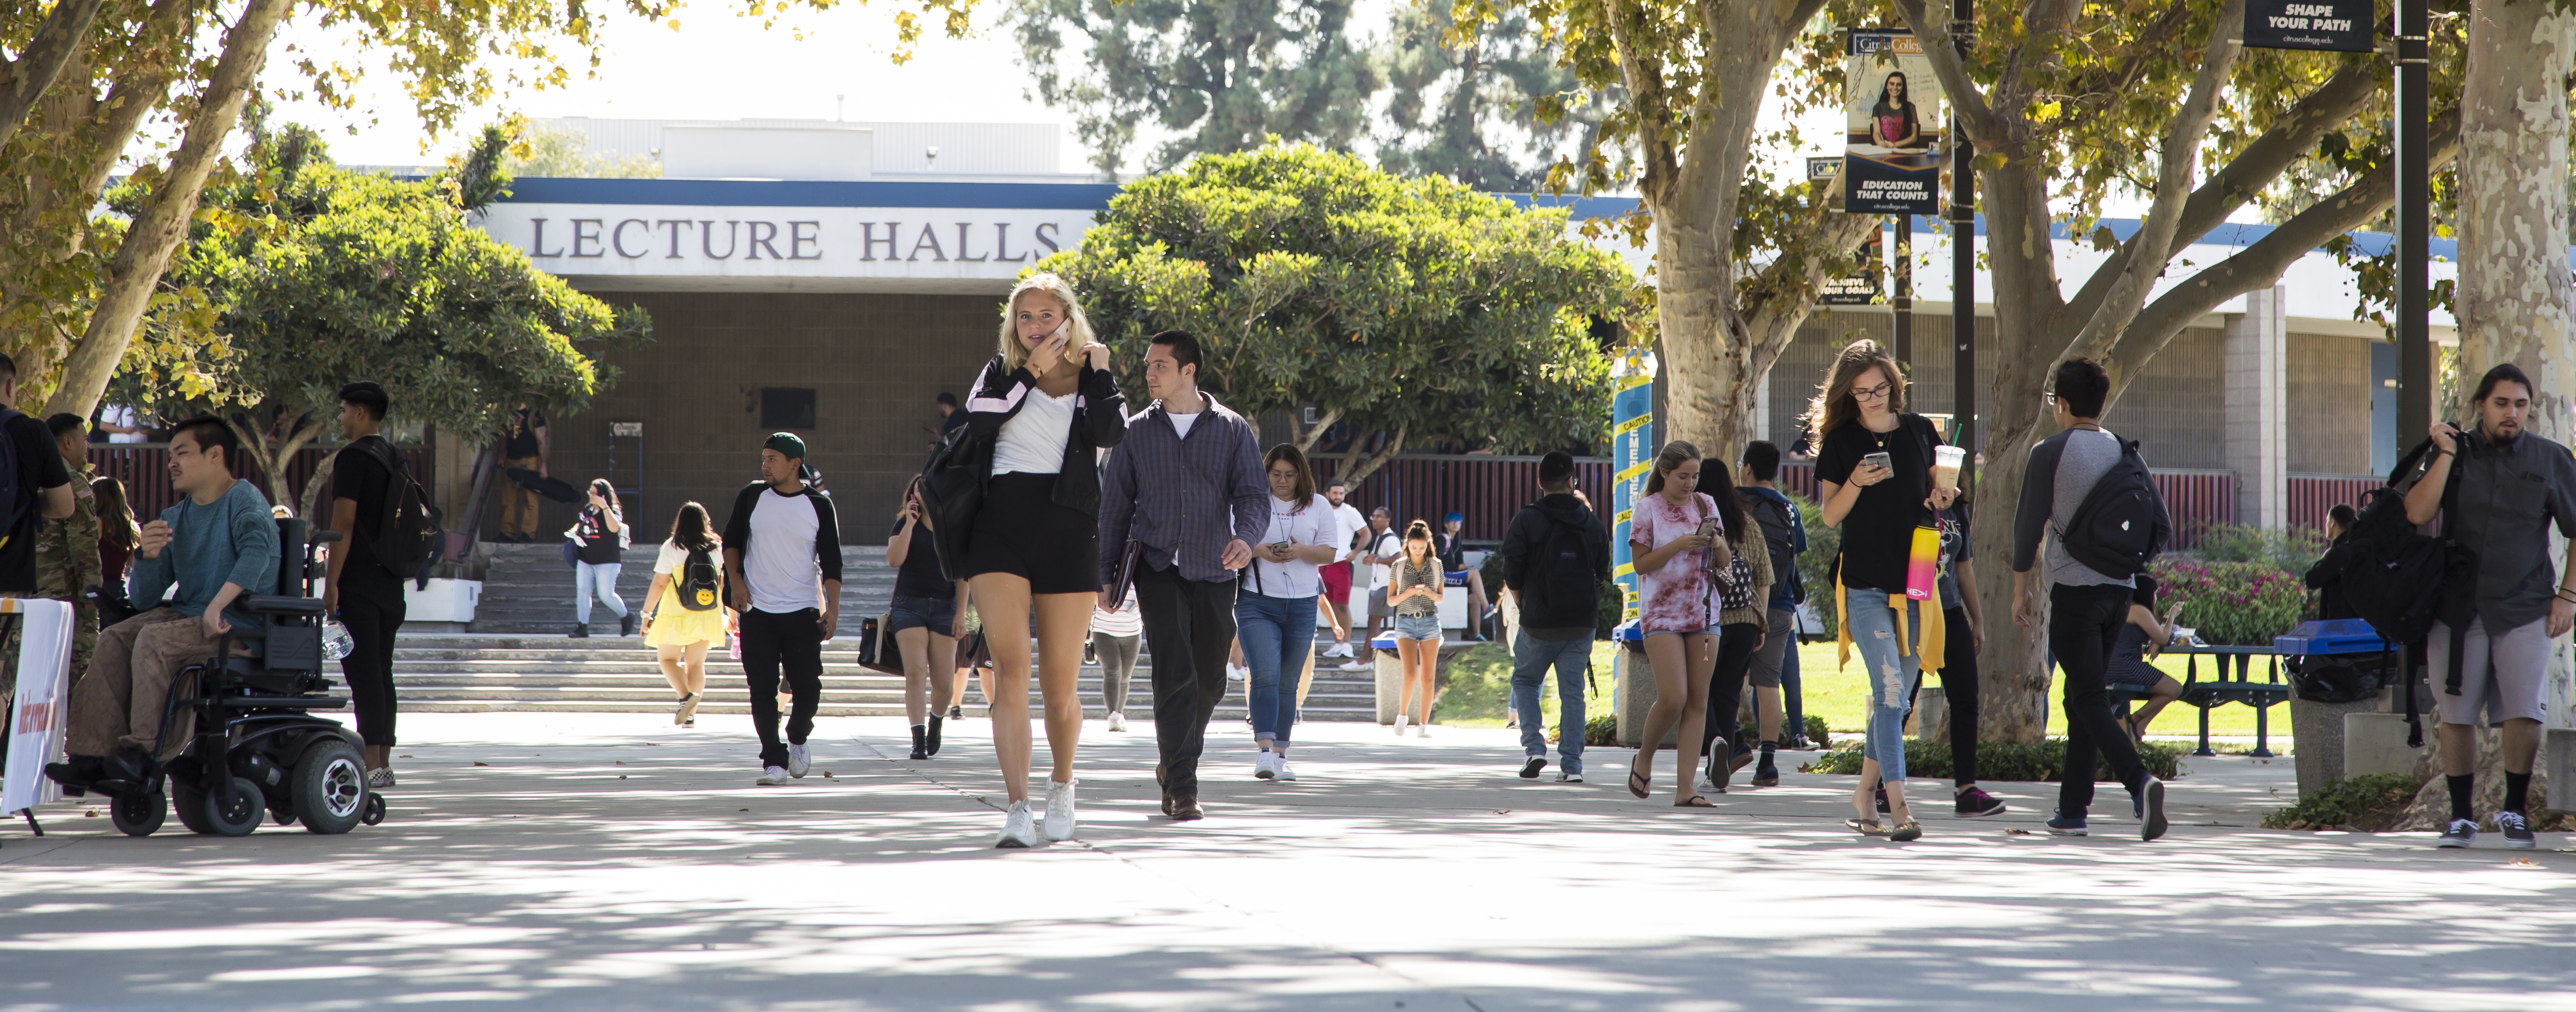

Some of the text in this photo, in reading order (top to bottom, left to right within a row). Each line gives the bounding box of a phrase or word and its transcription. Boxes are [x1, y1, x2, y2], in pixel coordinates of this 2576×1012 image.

[2285, 4, 2333, 17] SHAPE
[2268, 16, 2351, 31] YOUR PATH
[2283, 35, 2333, 45] citruscollege.edu
[1892, 39, 1923, 53] Colleg
[1862, 180, 1923, 190] EDUCATION
[1857, 190, 1928, 200] THAT COUNTS
[530, 218, 1059, 262] LECTURE HALLS
[1845, 286, 1875, 294] GOALS
